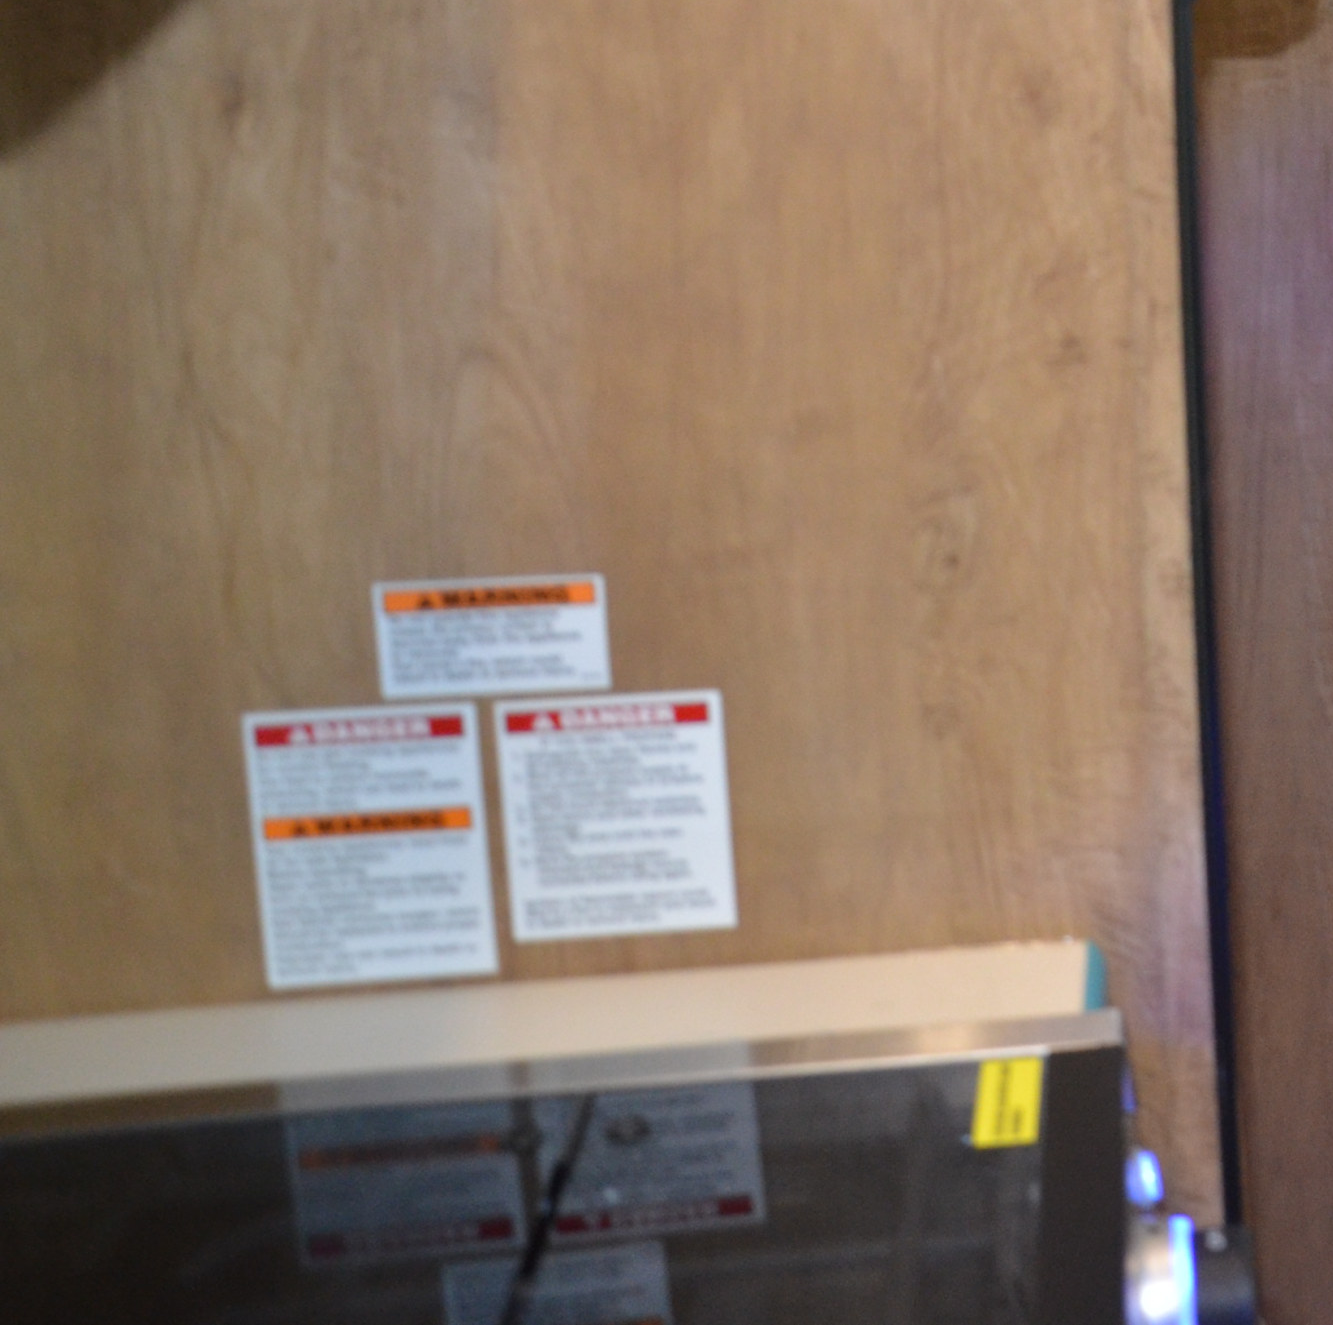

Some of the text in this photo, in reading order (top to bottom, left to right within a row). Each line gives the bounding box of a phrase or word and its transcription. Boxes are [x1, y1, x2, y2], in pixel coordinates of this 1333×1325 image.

[442, 584, 569, 606] WARNING
[562, 704, 676, 729] DANGER
[314, 717, 430, 743] DANGER
[317, 810, 445, 833] WARNING
